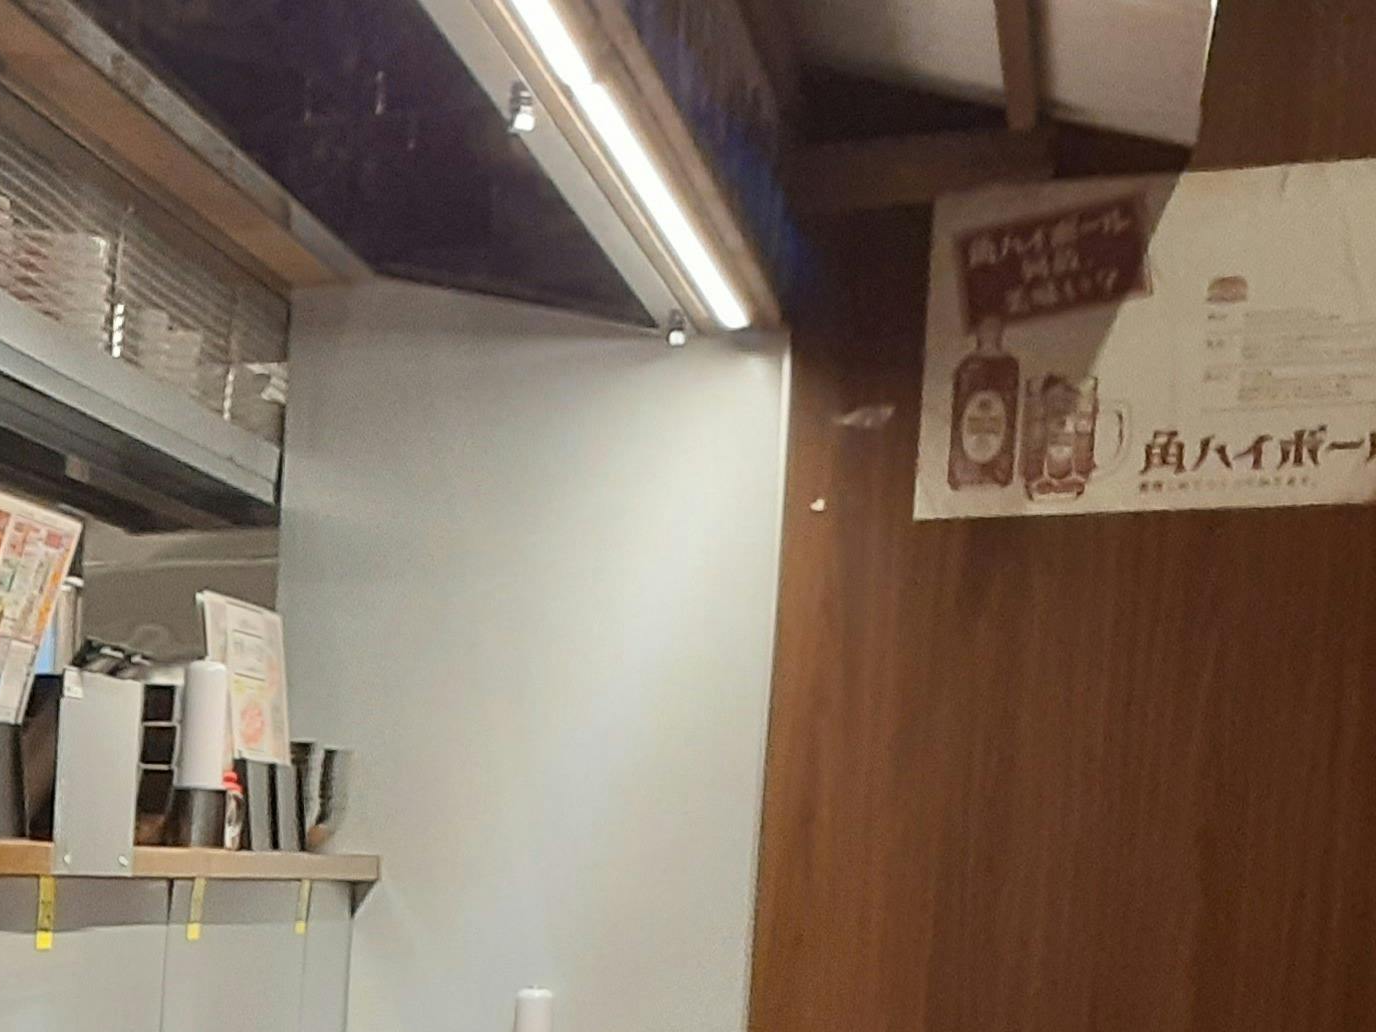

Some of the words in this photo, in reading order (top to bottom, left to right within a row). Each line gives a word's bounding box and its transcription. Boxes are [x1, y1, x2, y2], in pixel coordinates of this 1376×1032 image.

[1139, 424, 1376, 475] 角ハイボー
